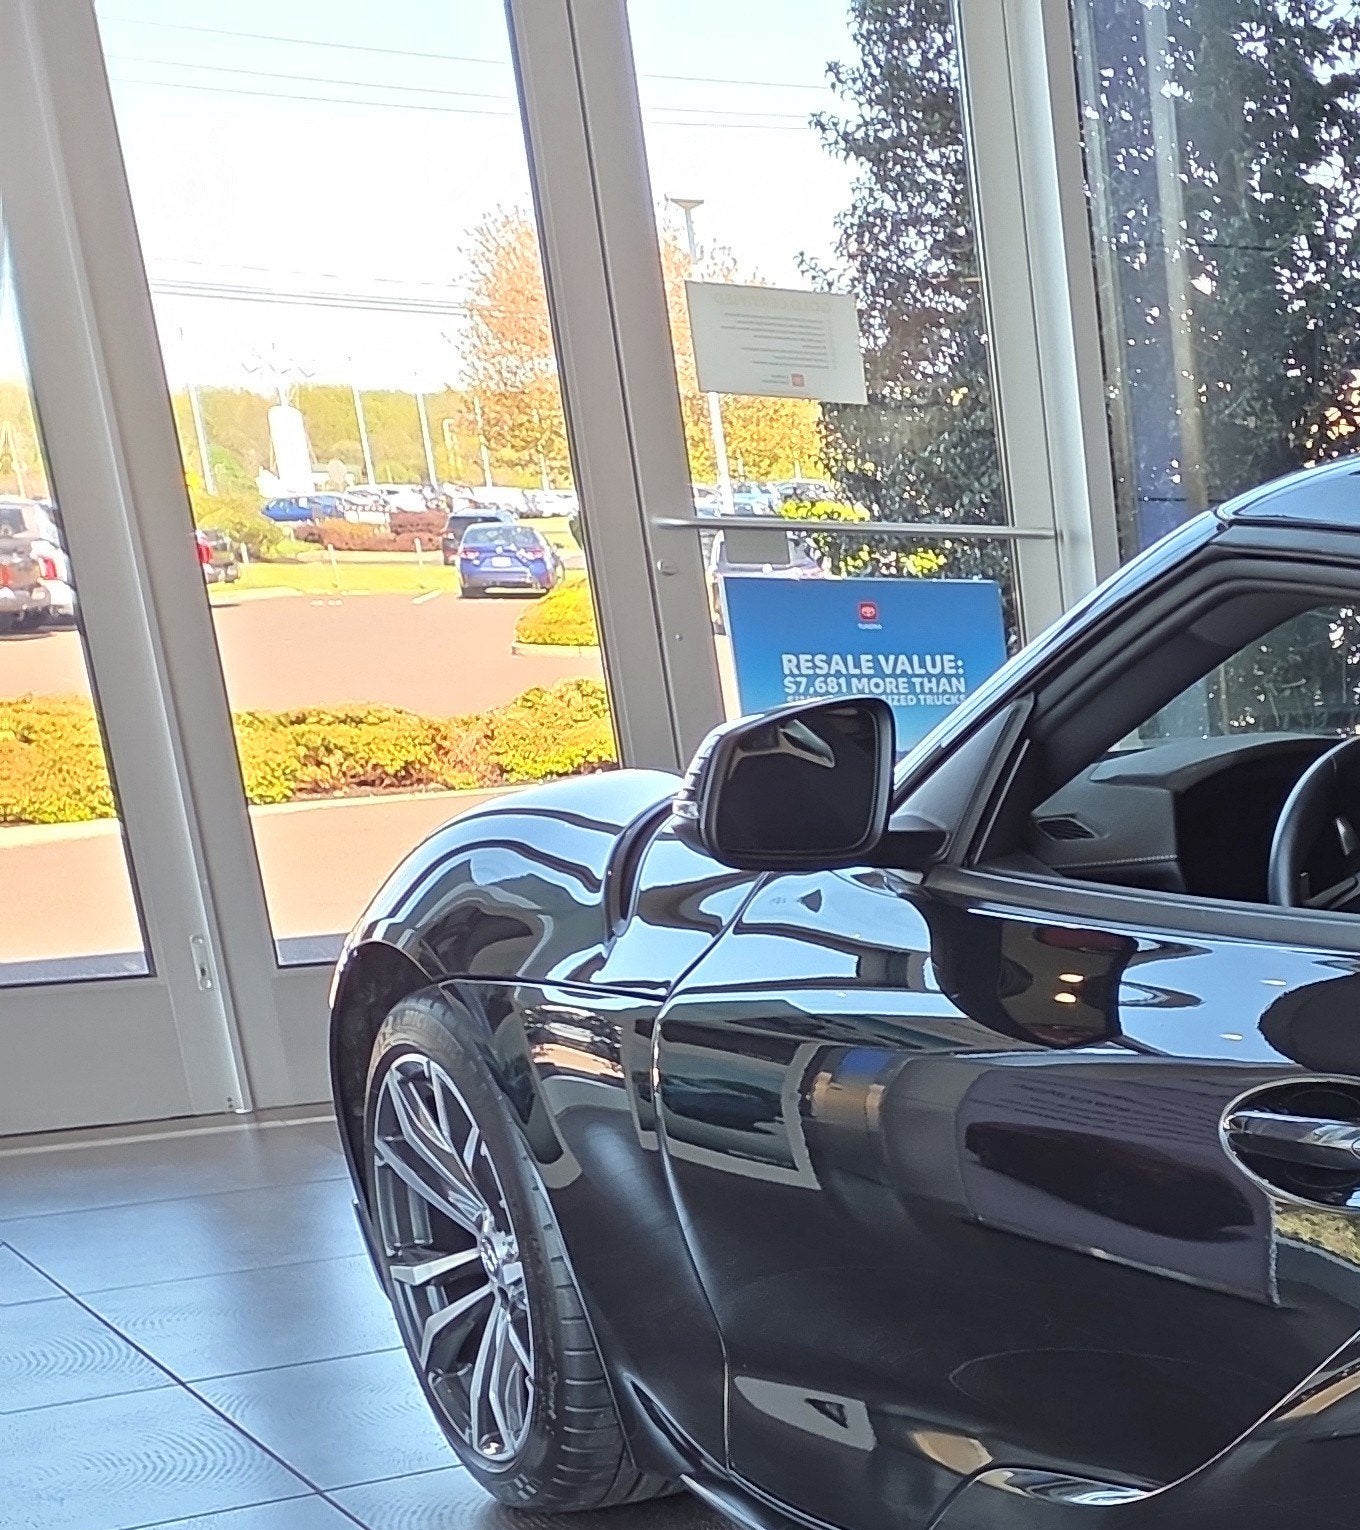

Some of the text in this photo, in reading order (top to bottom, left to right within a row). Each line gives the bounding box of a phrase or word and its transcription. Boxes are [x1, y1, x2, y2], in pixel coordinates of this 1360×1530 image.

[781, 653, 965, 675] RESALE VALUE:
[783, 676, 966, 694] $7,681 MORE THAN
[918, 694, 966, 706] TRUCKS
